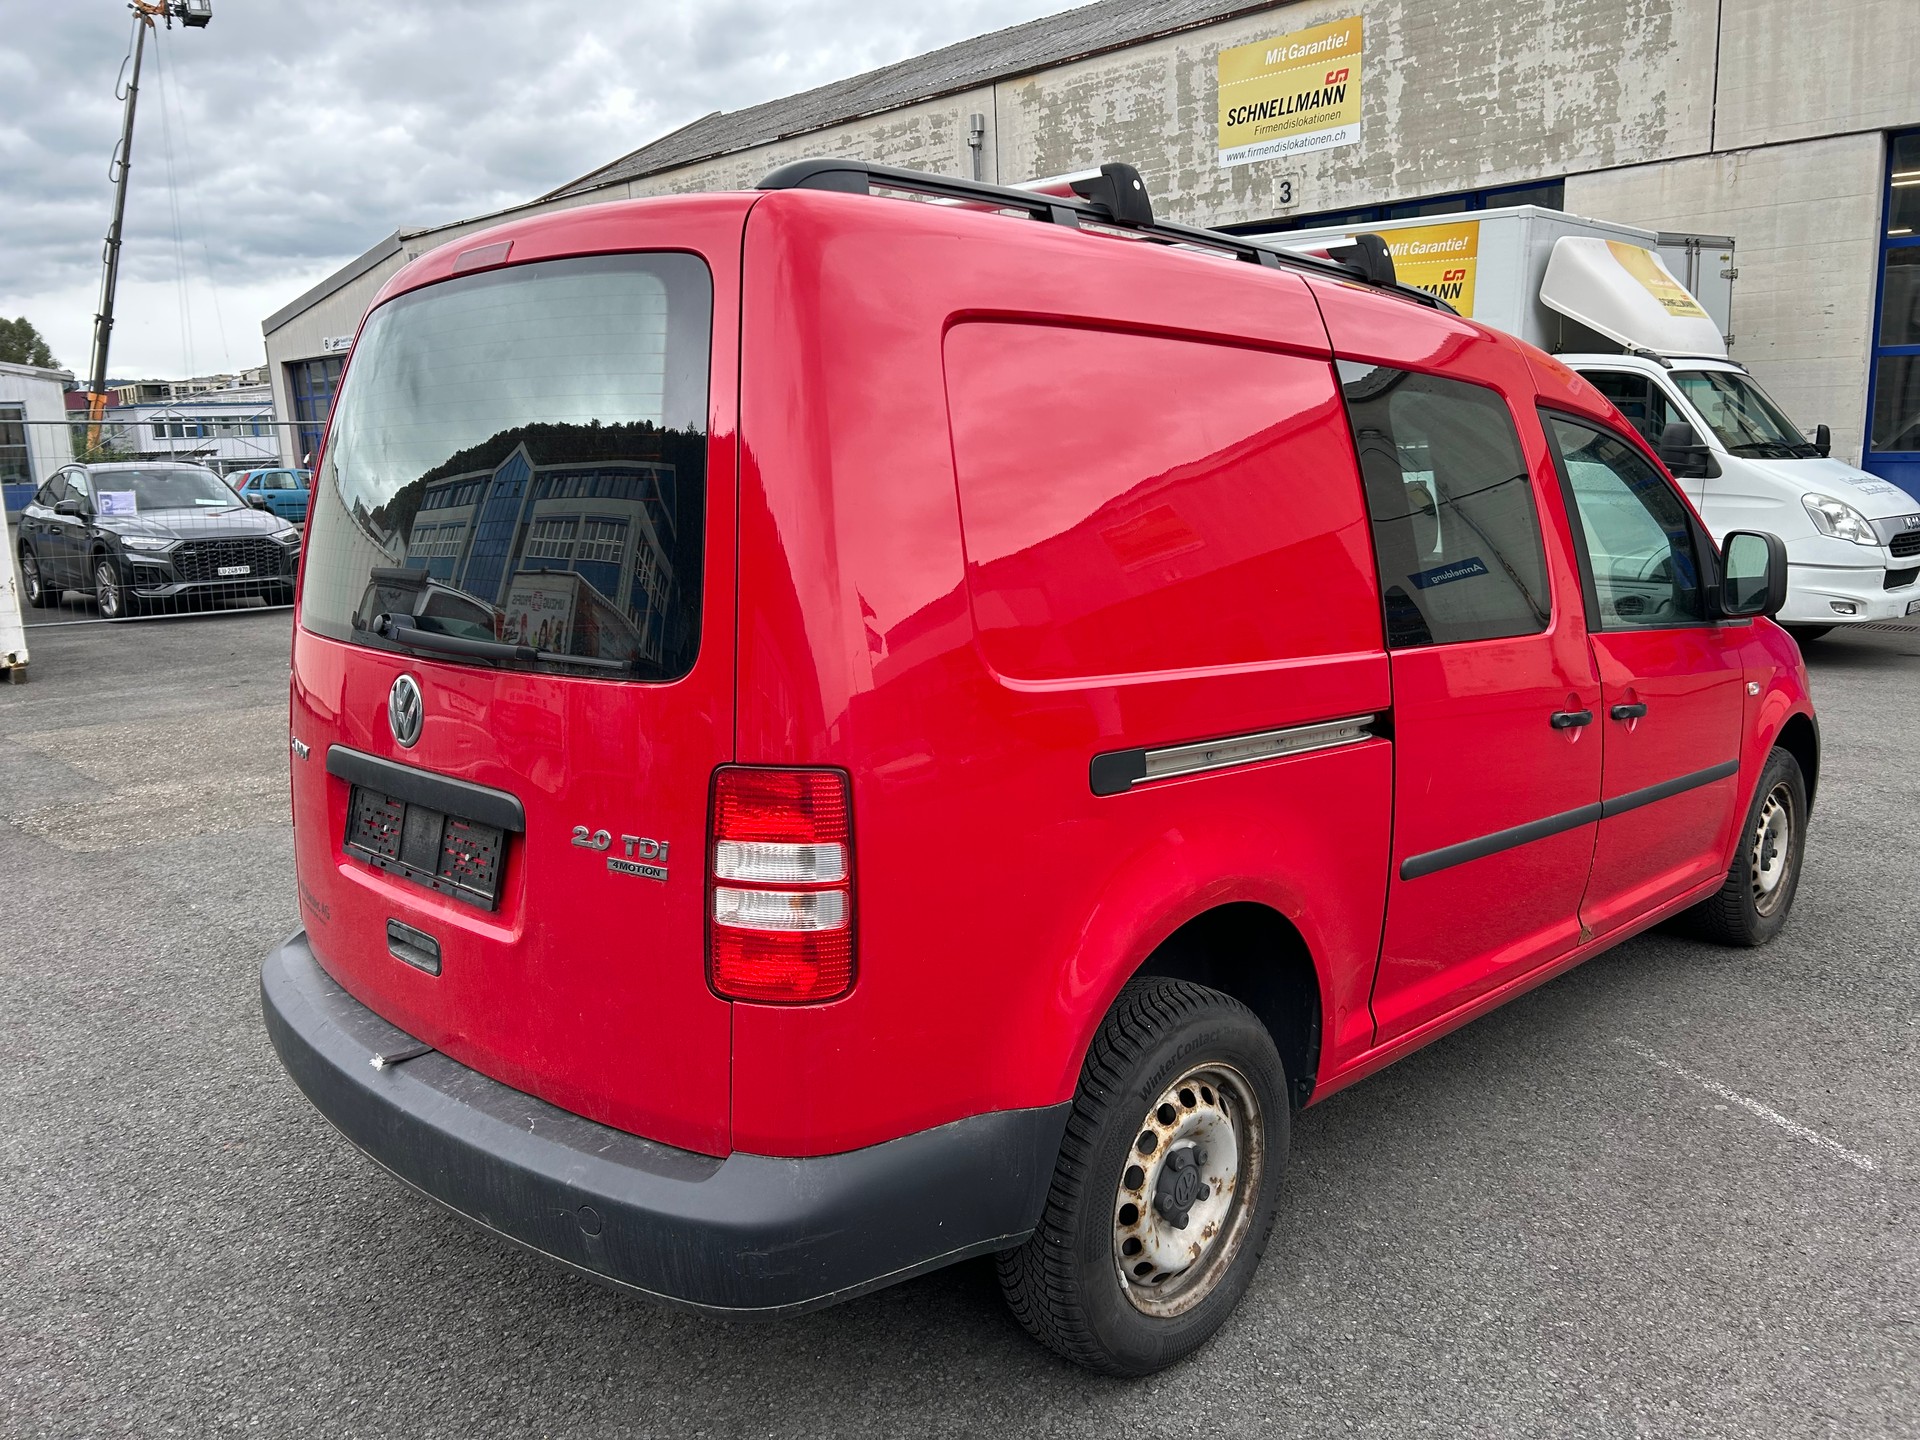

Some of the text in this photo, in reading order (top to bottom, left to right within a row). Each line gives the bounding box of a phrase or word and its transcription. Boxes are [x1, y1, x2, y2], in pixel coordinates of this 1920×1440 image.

[1265, 31, 1350, 66] Mit Garantie!
[1227, 84, 1346, 127] SCHNELLMANN
[1254, 110, 1342, 136] Firmendislokationen
[1226, 130, 1346, 162] www.firmendislokationen.ch
[1279, 181, 1292, 204] 3
[1389, 237, 1469, 257] Mit Garantie!
[570, 825, 612, 851] 2.0
[612, 860, 661, 877] 4MOTION
[1139, 1029, 1220, 1102] WinterContact
